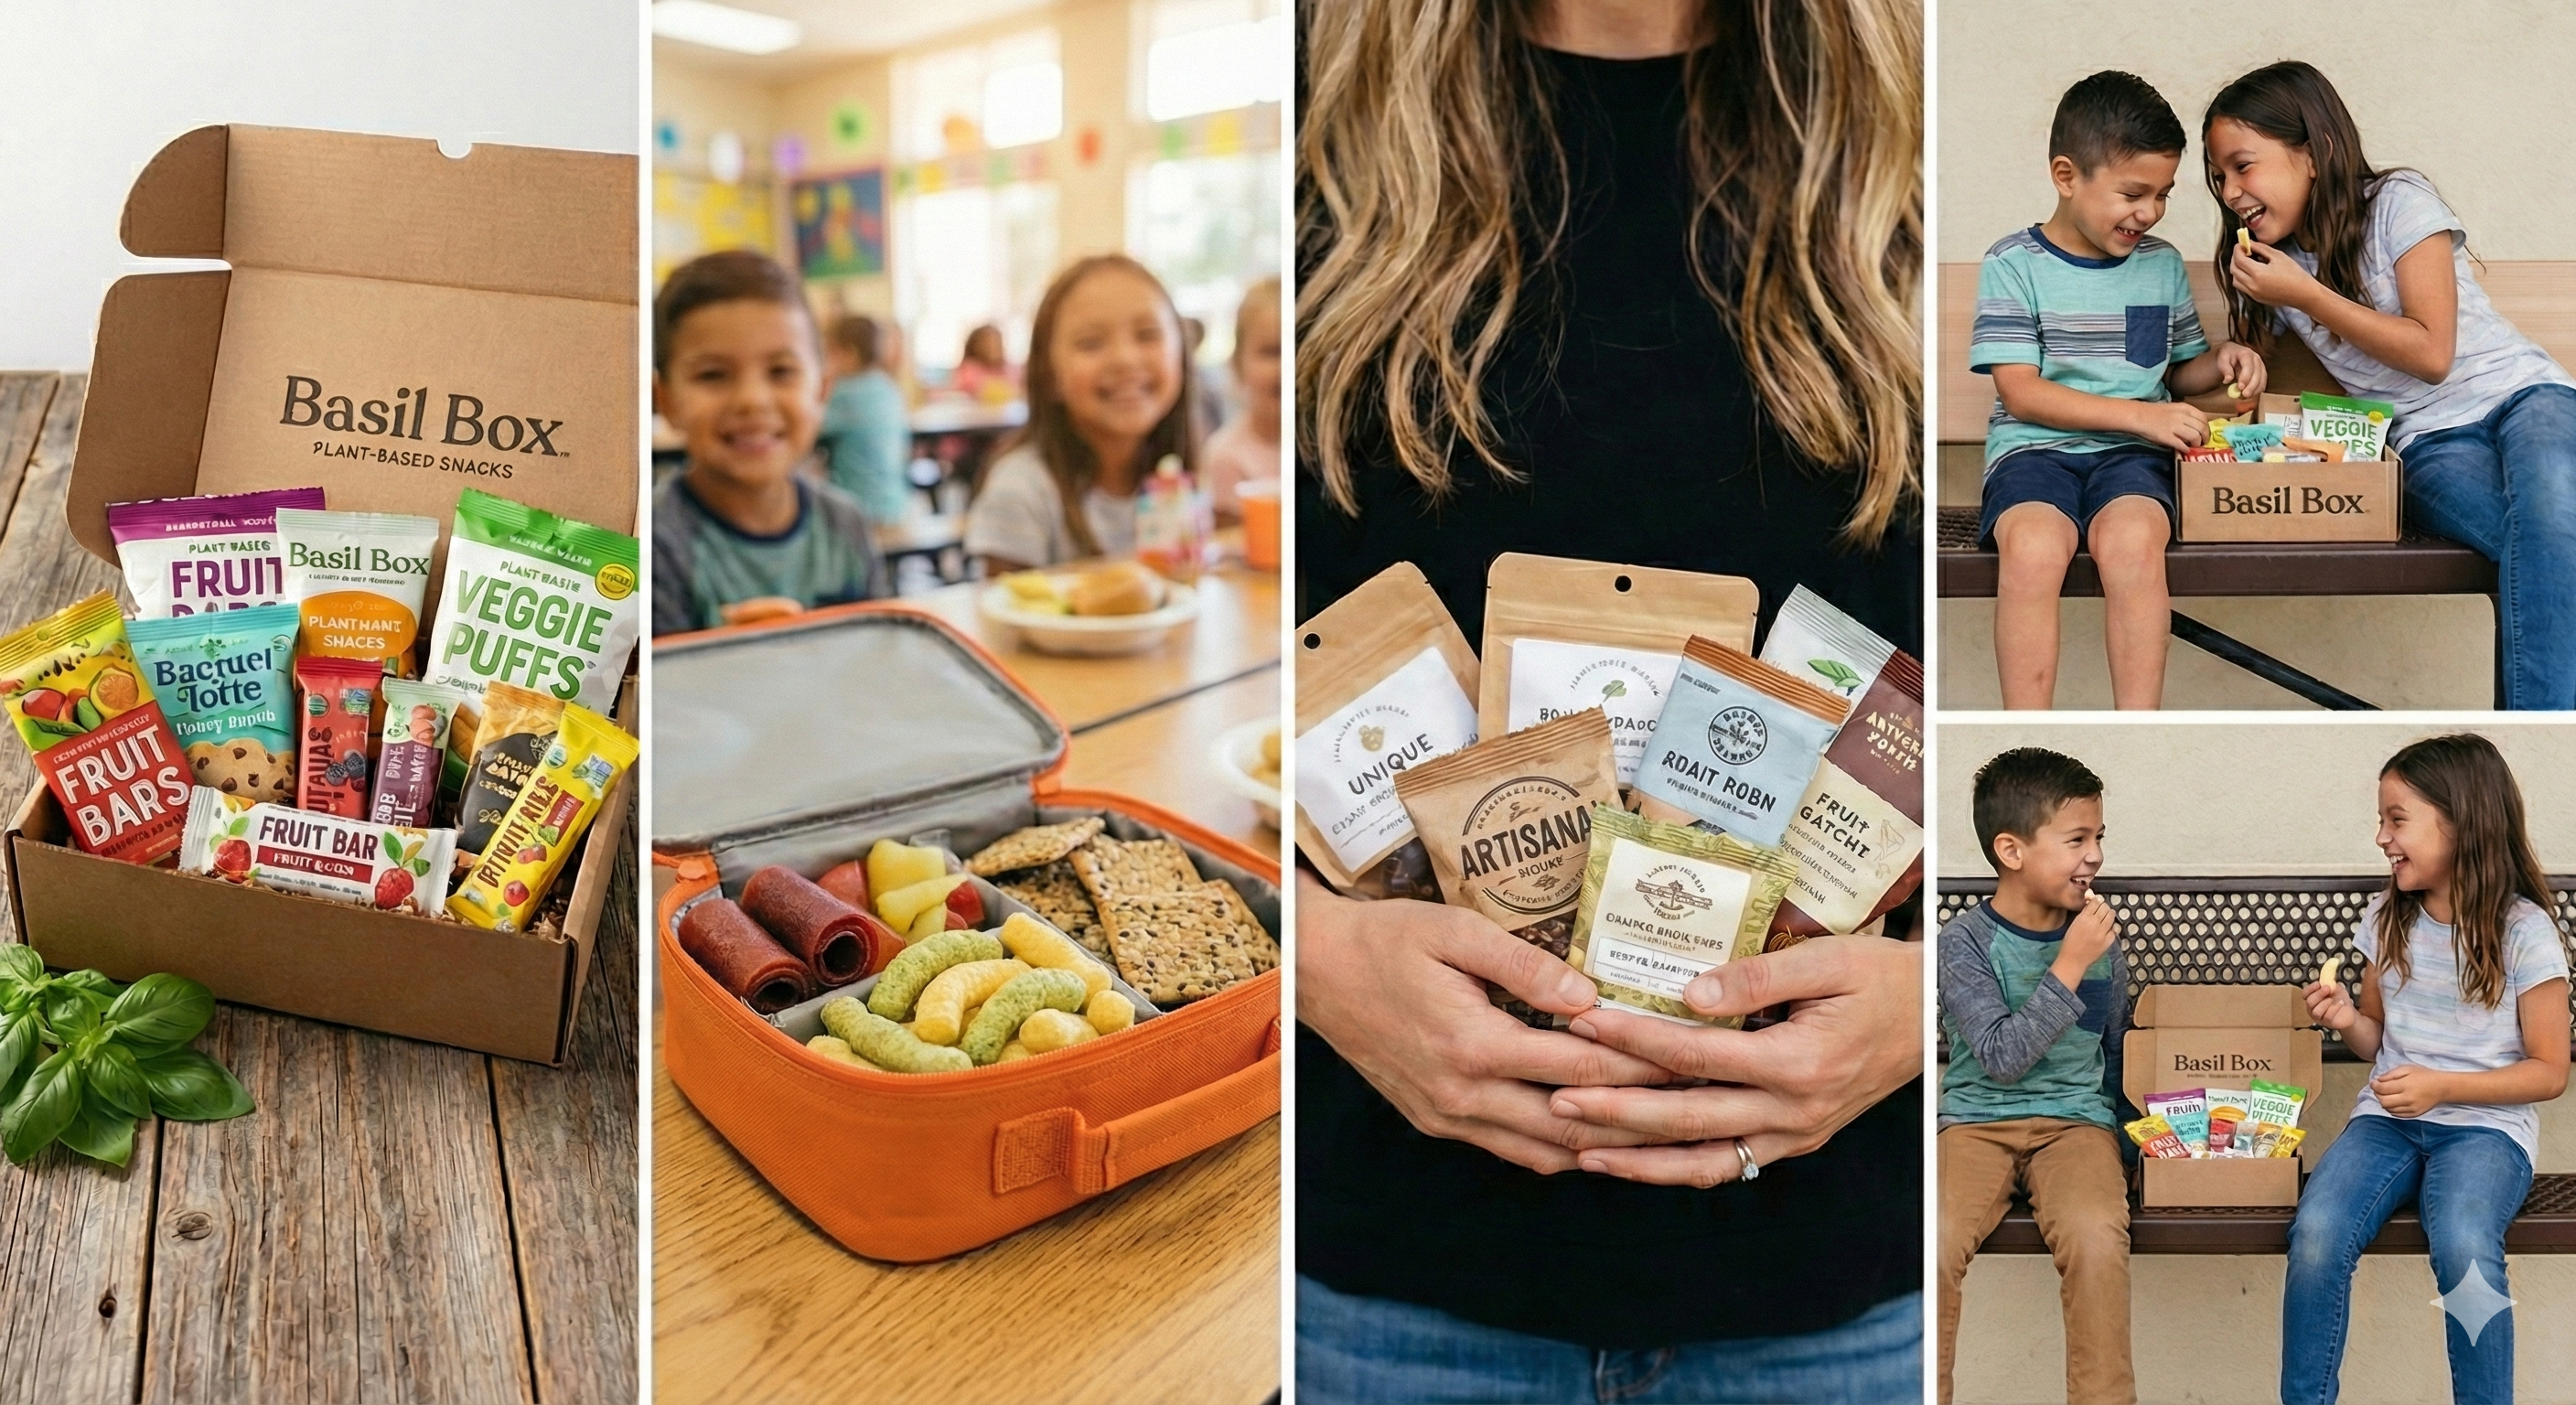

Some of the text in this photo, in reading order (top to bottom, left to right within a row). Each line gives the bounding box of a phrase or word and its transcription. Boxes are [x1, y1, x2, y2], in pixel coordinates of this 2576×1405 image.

[279, 375, 427, 441] Basil
[313, 441, 513, 479] PLANT-BASED SNACKS
[2211, 486, 2365, 514] Basil Box
[172, 557, 283, 598] FRUIT
[288, 542, 429, 575] Basil Box
[457, 569, 613, 654] VEGGIE
[442, 621, 585, 700] PUFFS
[55, 724, 166, 804] FRUIT
[1347, 734, 1433, 795] UNIQUE
[76, 767, 189, 847] BARS
[1723, 777, 1776, 812] ROBN
[1816, 792, 1870, 834] FRUIT
[259, 816, 378, 861] FRUIT BAR
[2174, 1054, 2272, 1071] Basil Box
